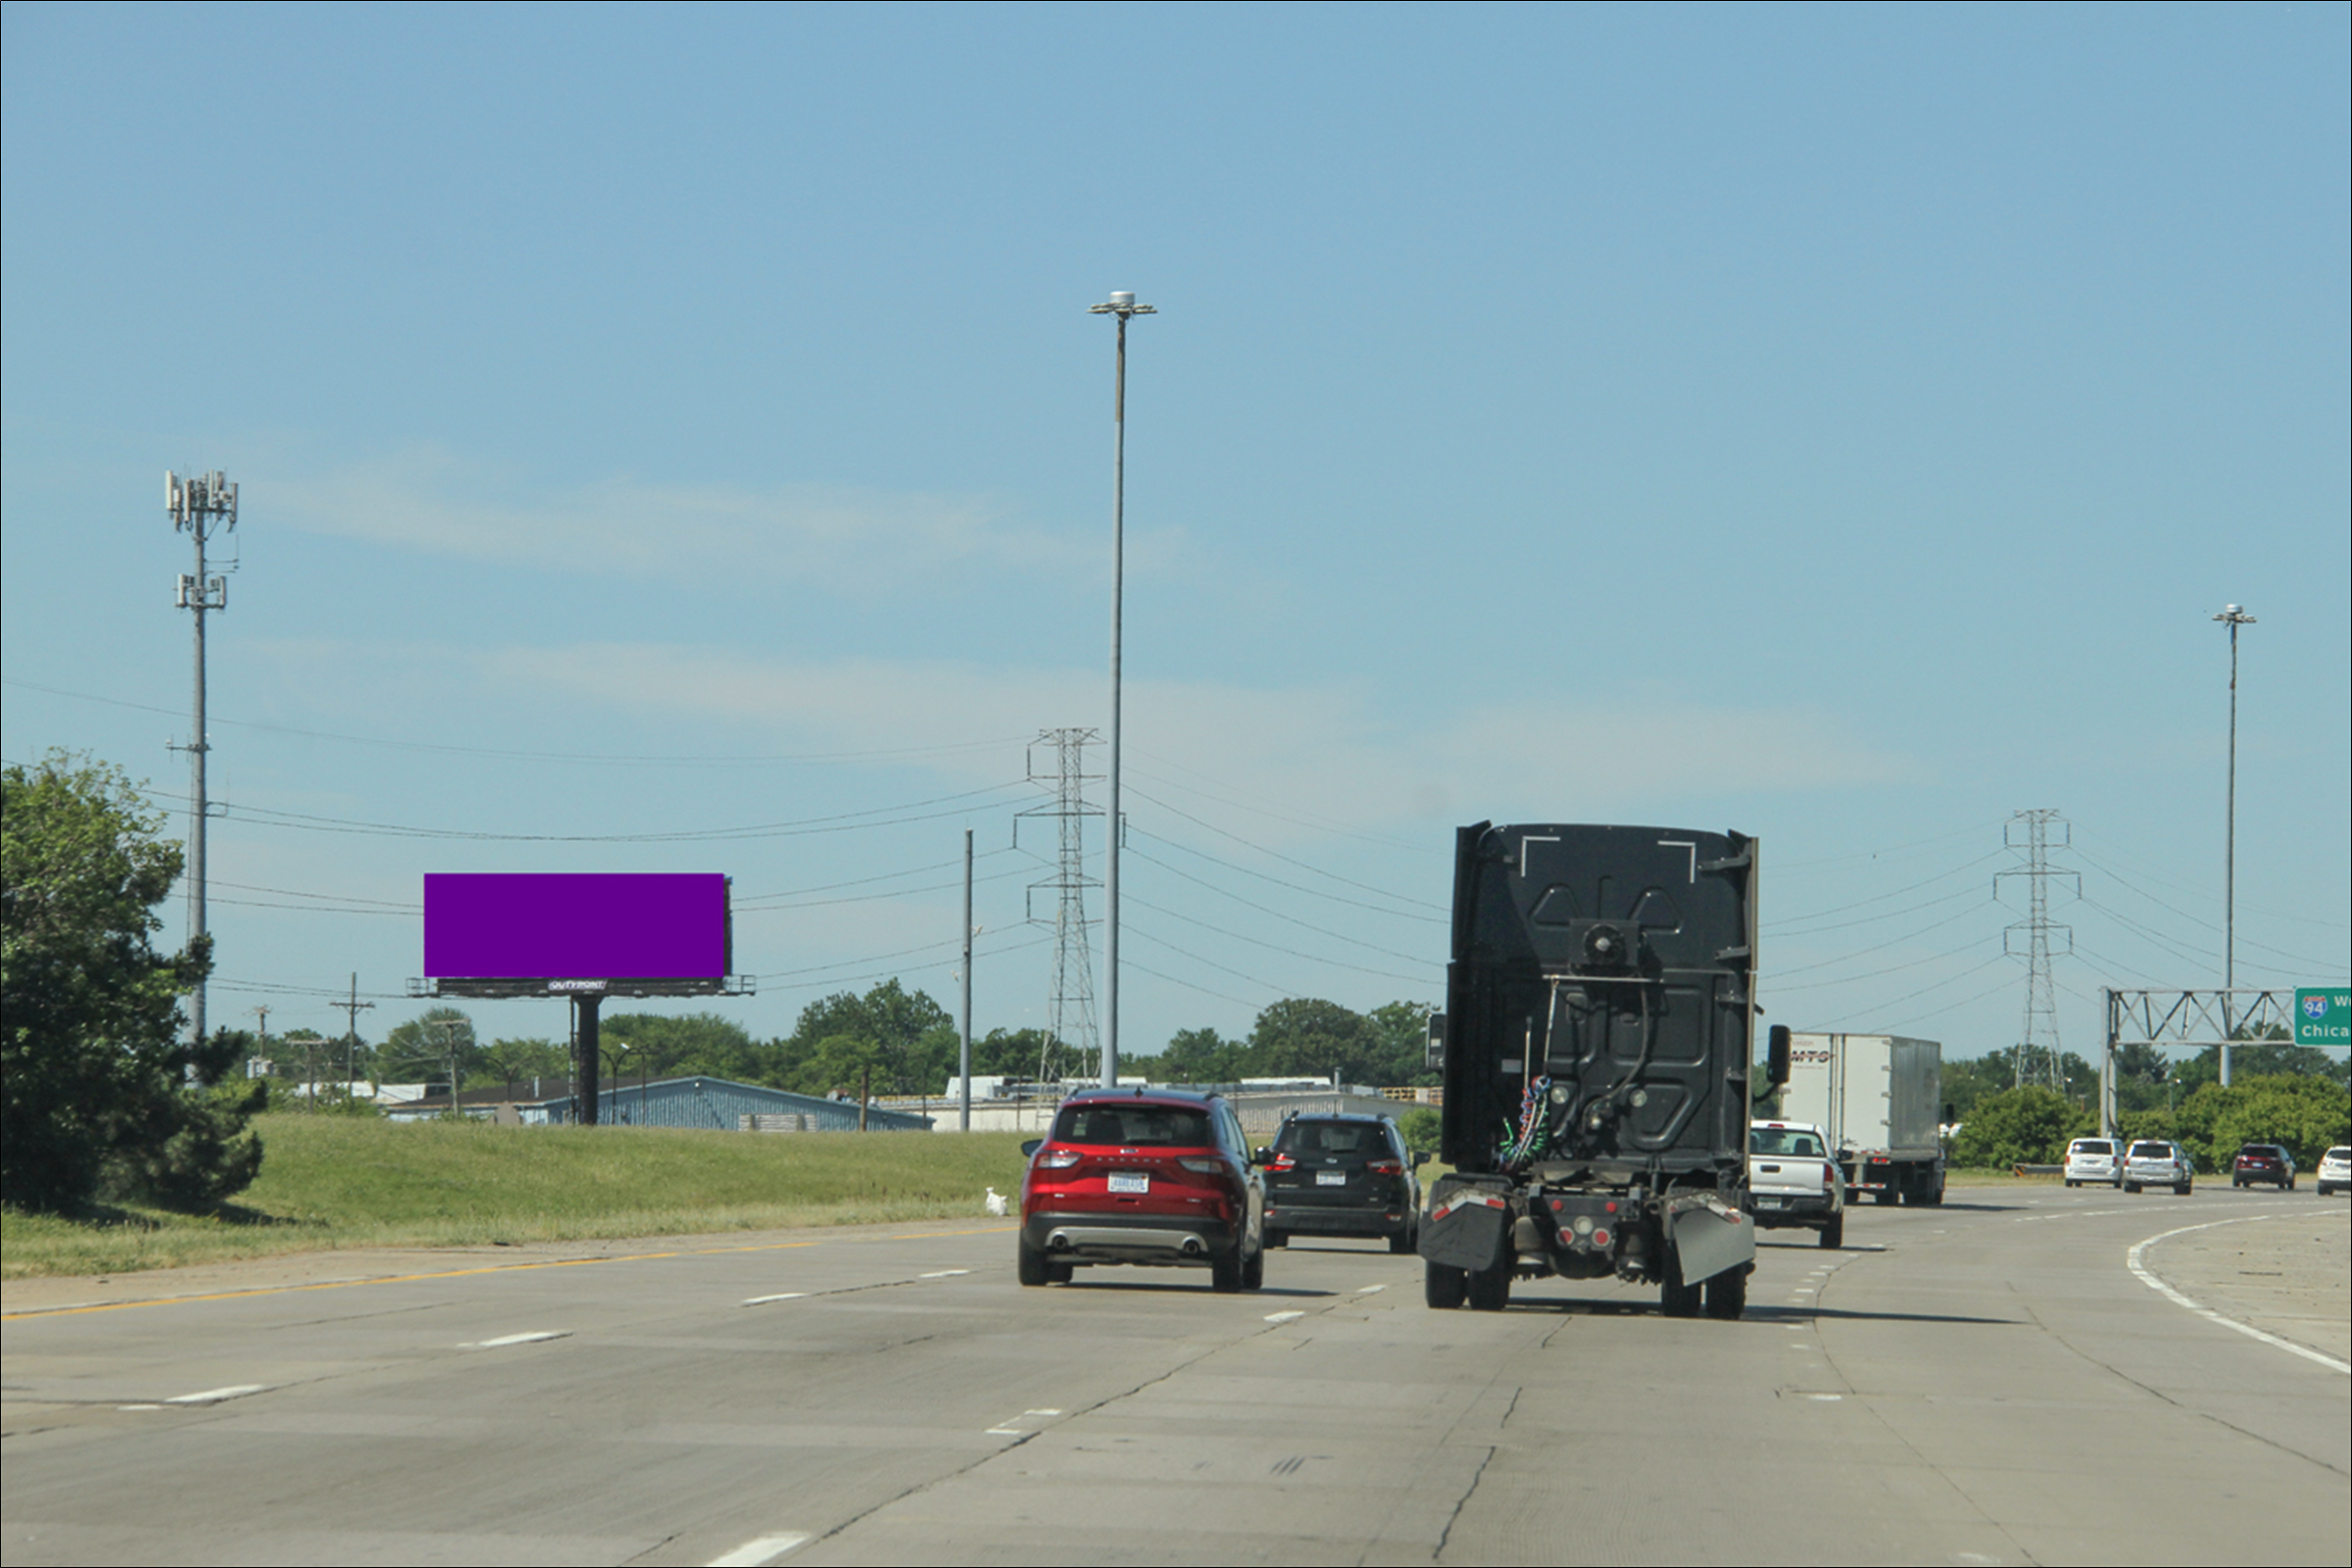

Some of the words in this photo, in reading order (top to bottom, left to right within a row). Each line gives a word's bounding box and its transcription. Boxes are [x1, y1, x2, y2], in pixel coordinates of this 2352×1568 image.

[2333, 996, 2351, 1007] W
[2304, 1002, 2324, 1013] 94
[2301, 1024, 2351, 1038] Chica
